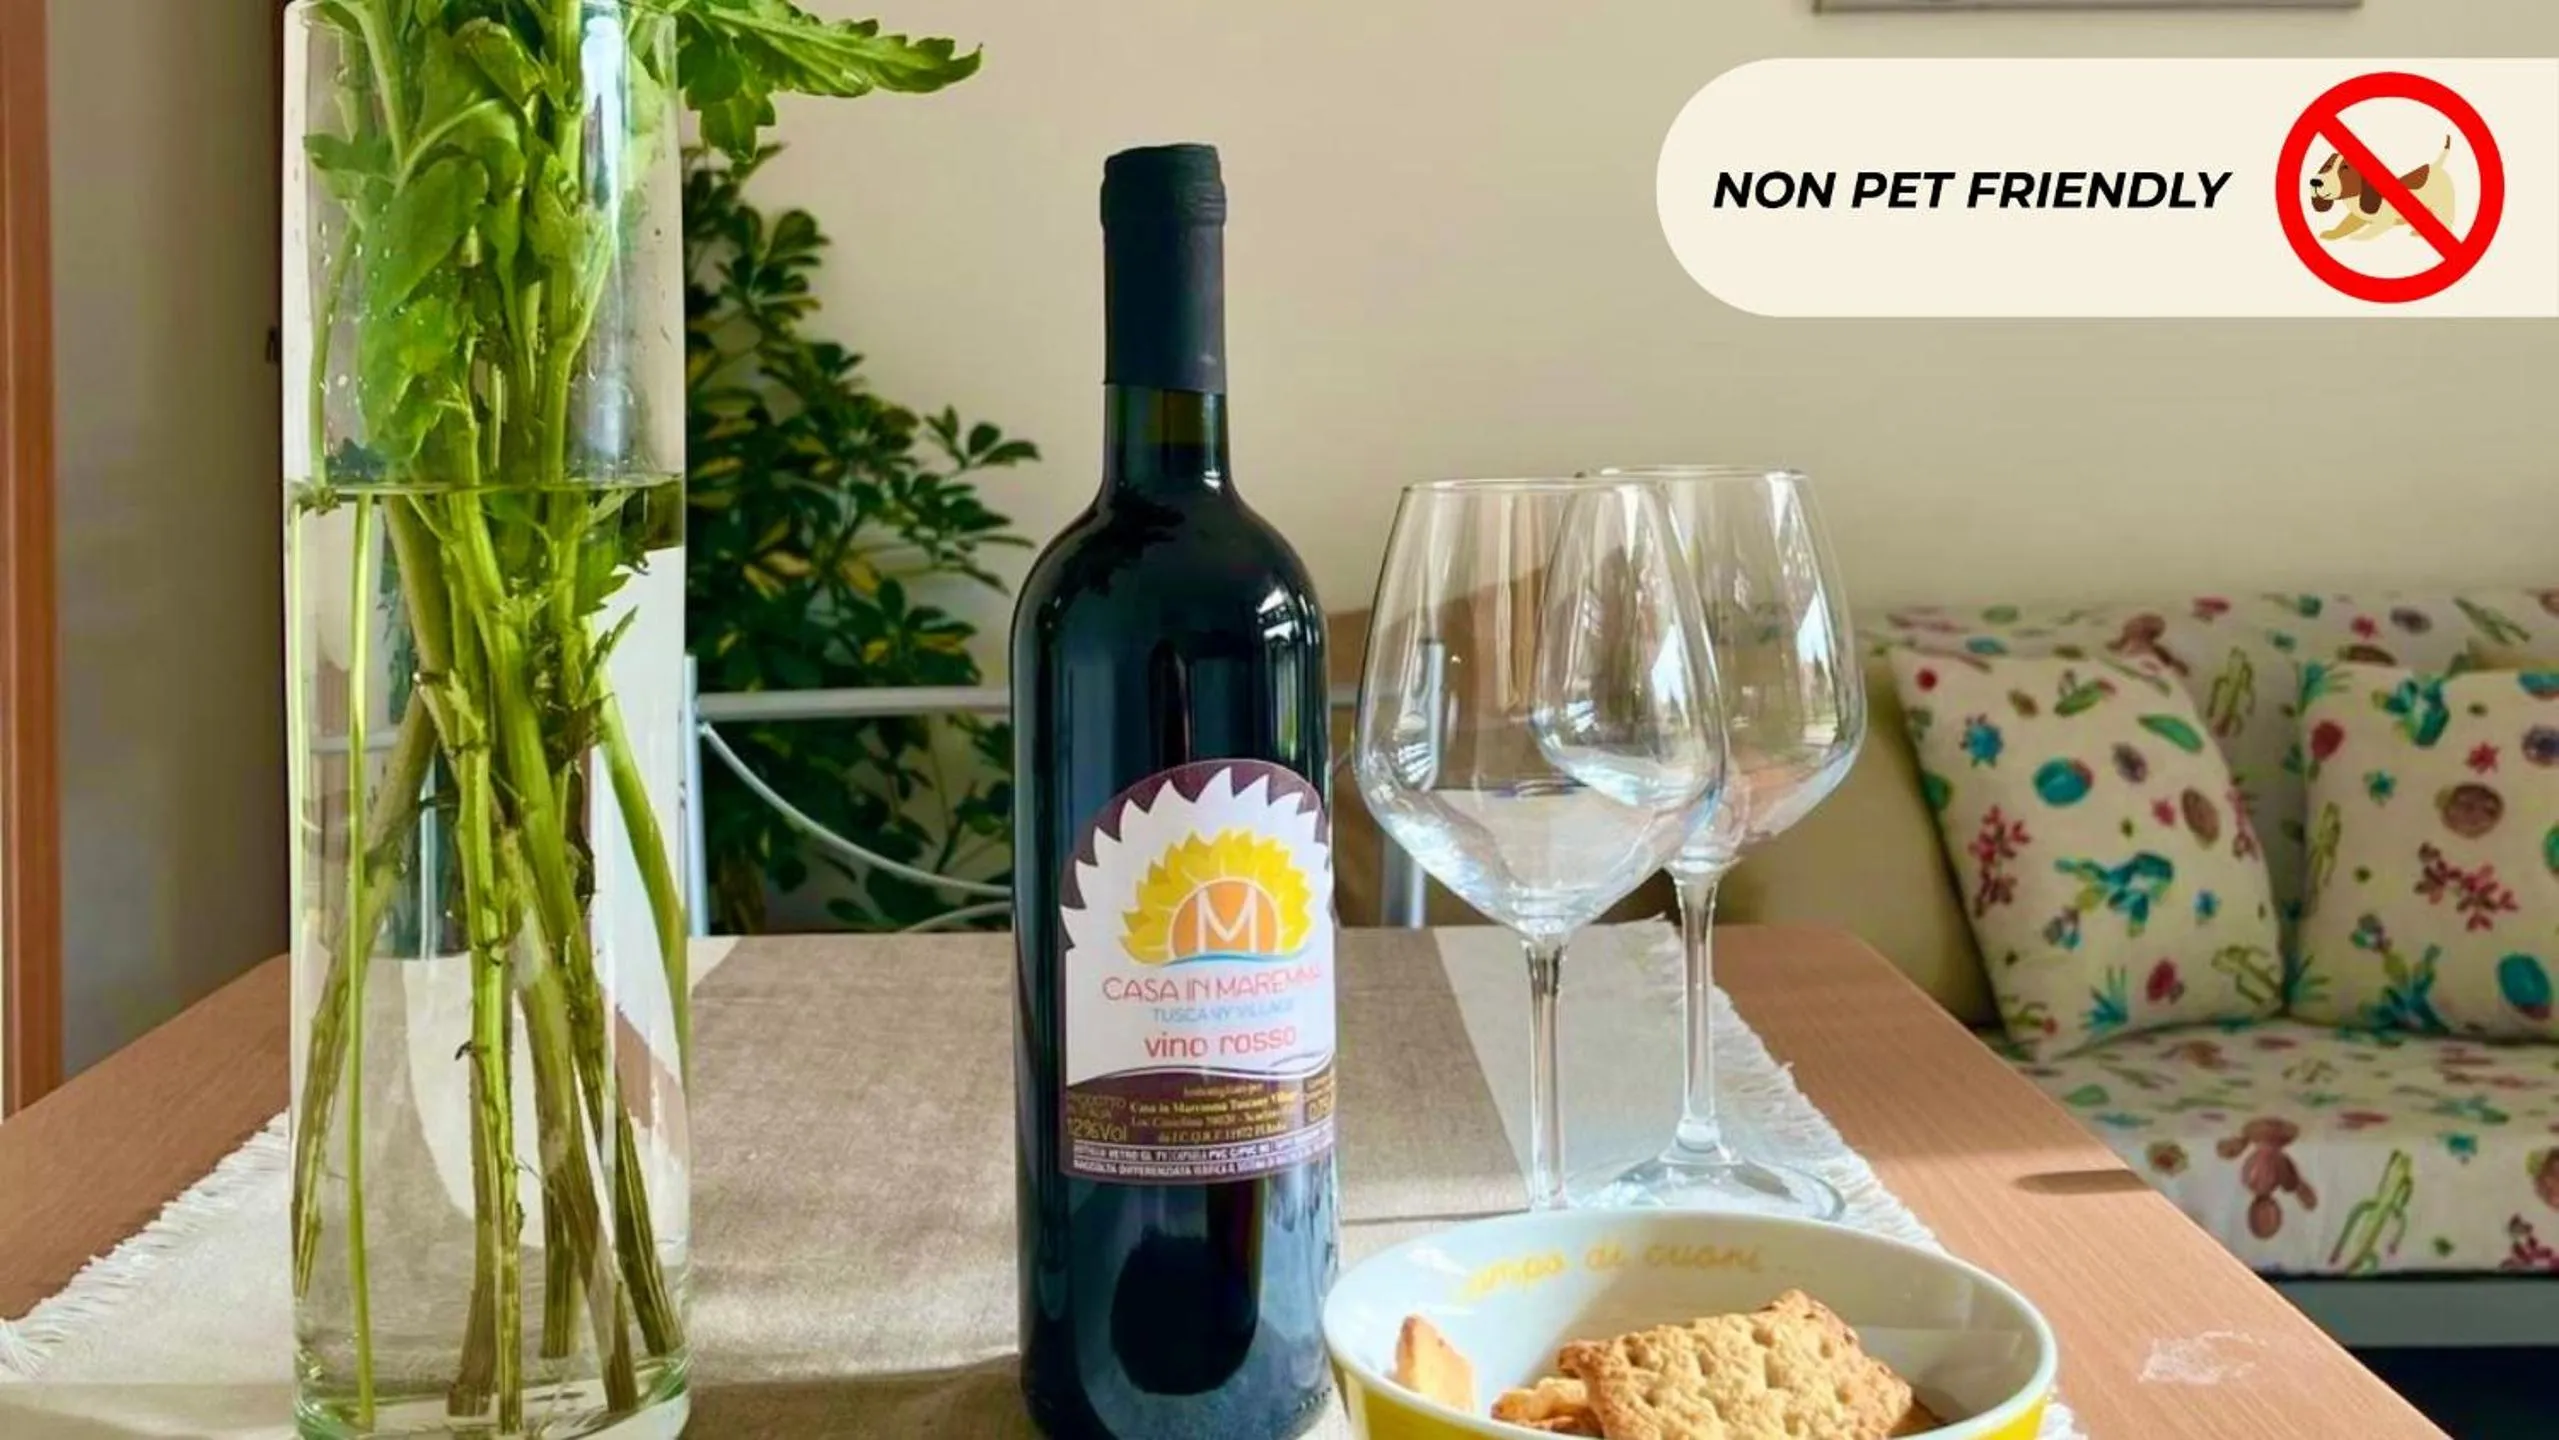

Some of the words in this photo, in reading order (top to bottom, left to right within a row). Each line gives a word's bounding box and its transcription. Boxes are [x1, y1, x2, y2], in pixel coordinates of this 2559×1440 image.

[1102, 976, 1180, 1002] CASA
[1185, 978, 1210, 1001] IN
[1143, 1031, 1209, 1058] vino
[1219, 1025, 1298, 1056] rosso
